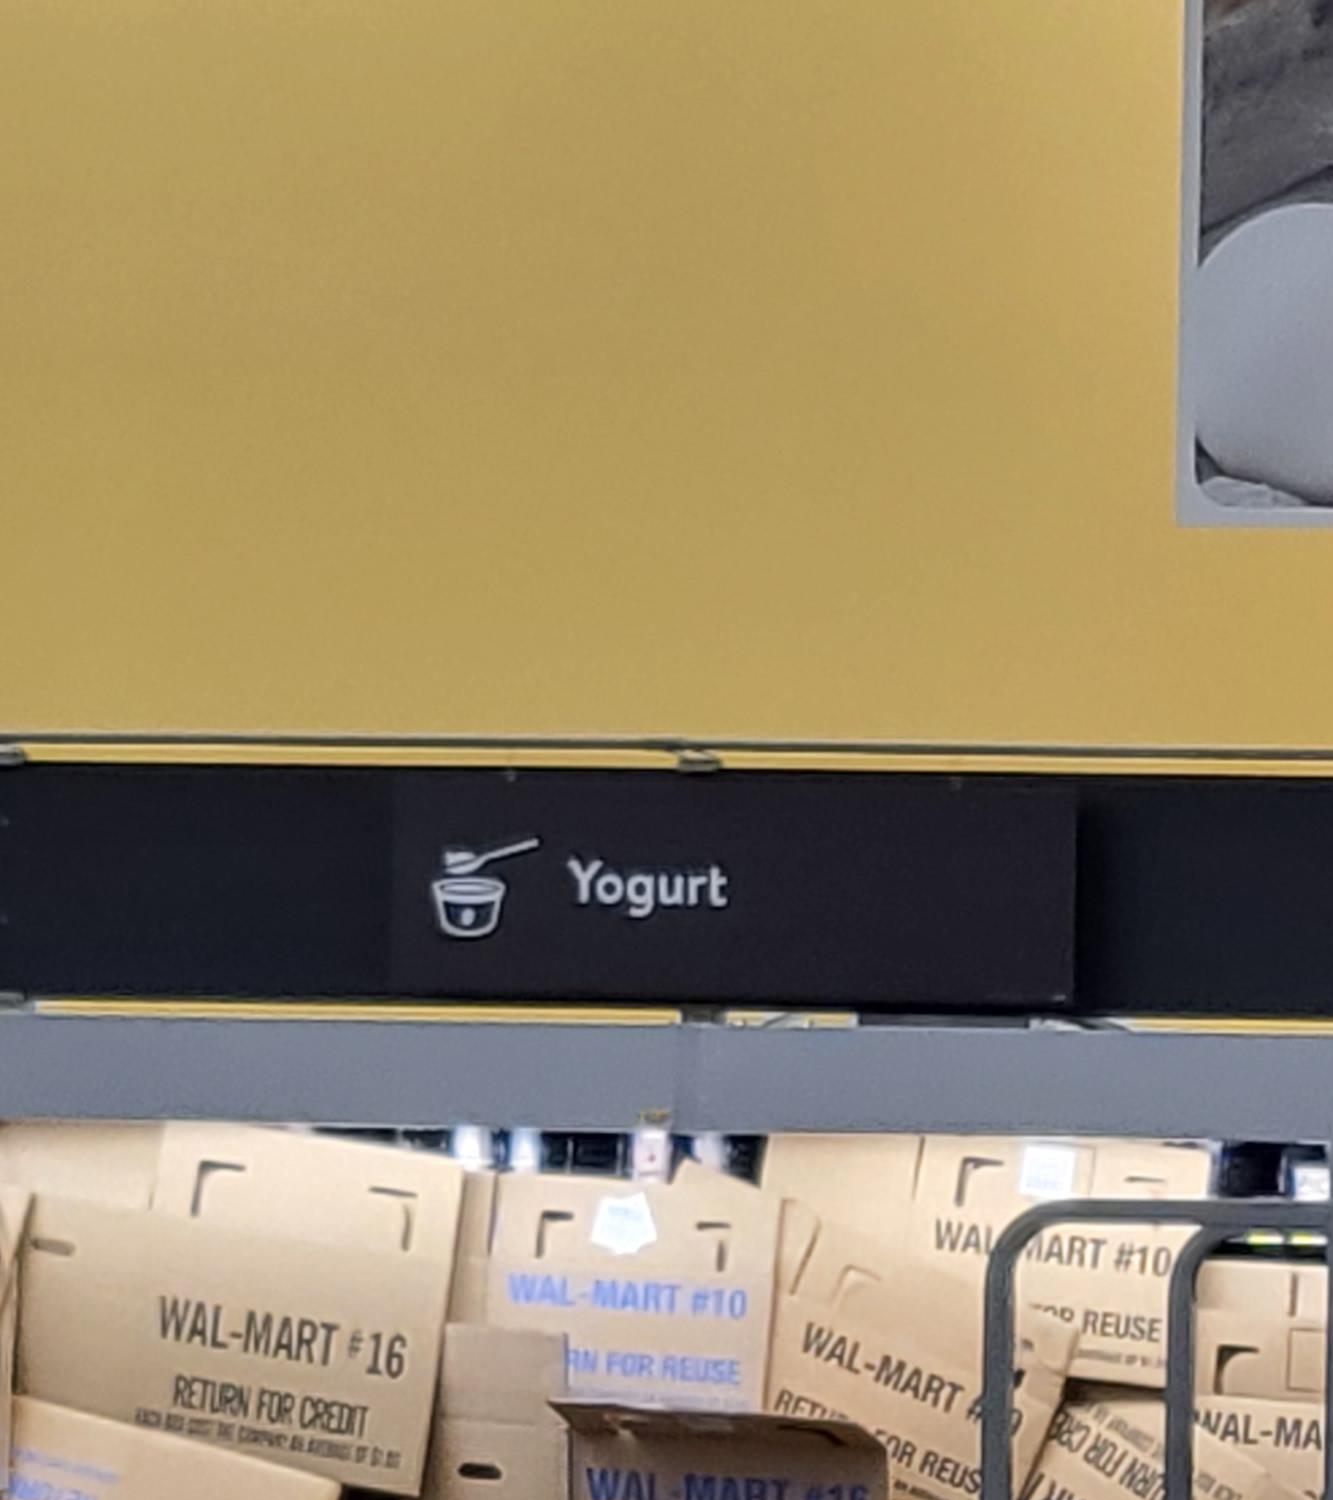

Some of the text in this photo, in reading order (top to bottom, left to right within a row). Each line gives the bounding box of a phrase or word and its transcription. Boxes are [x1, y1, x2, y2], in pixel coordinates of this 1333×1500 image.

[567, 858, 729, 918] Yogurt
[1114, 1242, 1172, 1278] #10
[508, 1272, 748, 1321] WAL-MART #10
[157, 1295, 408, 1379] WAL-MART #16
[1082, 1308, 1163, 1343] REUSE
[606, 1352, 654, 1378] FOR
[662, 1356, 742, 1387] REUSE
[802, 1320, 965, 1414] WAL-MART
[172, 1373, 369, 1439] RETURN FOR CREDIT
[919, 1450, 982, 1494] REUS
